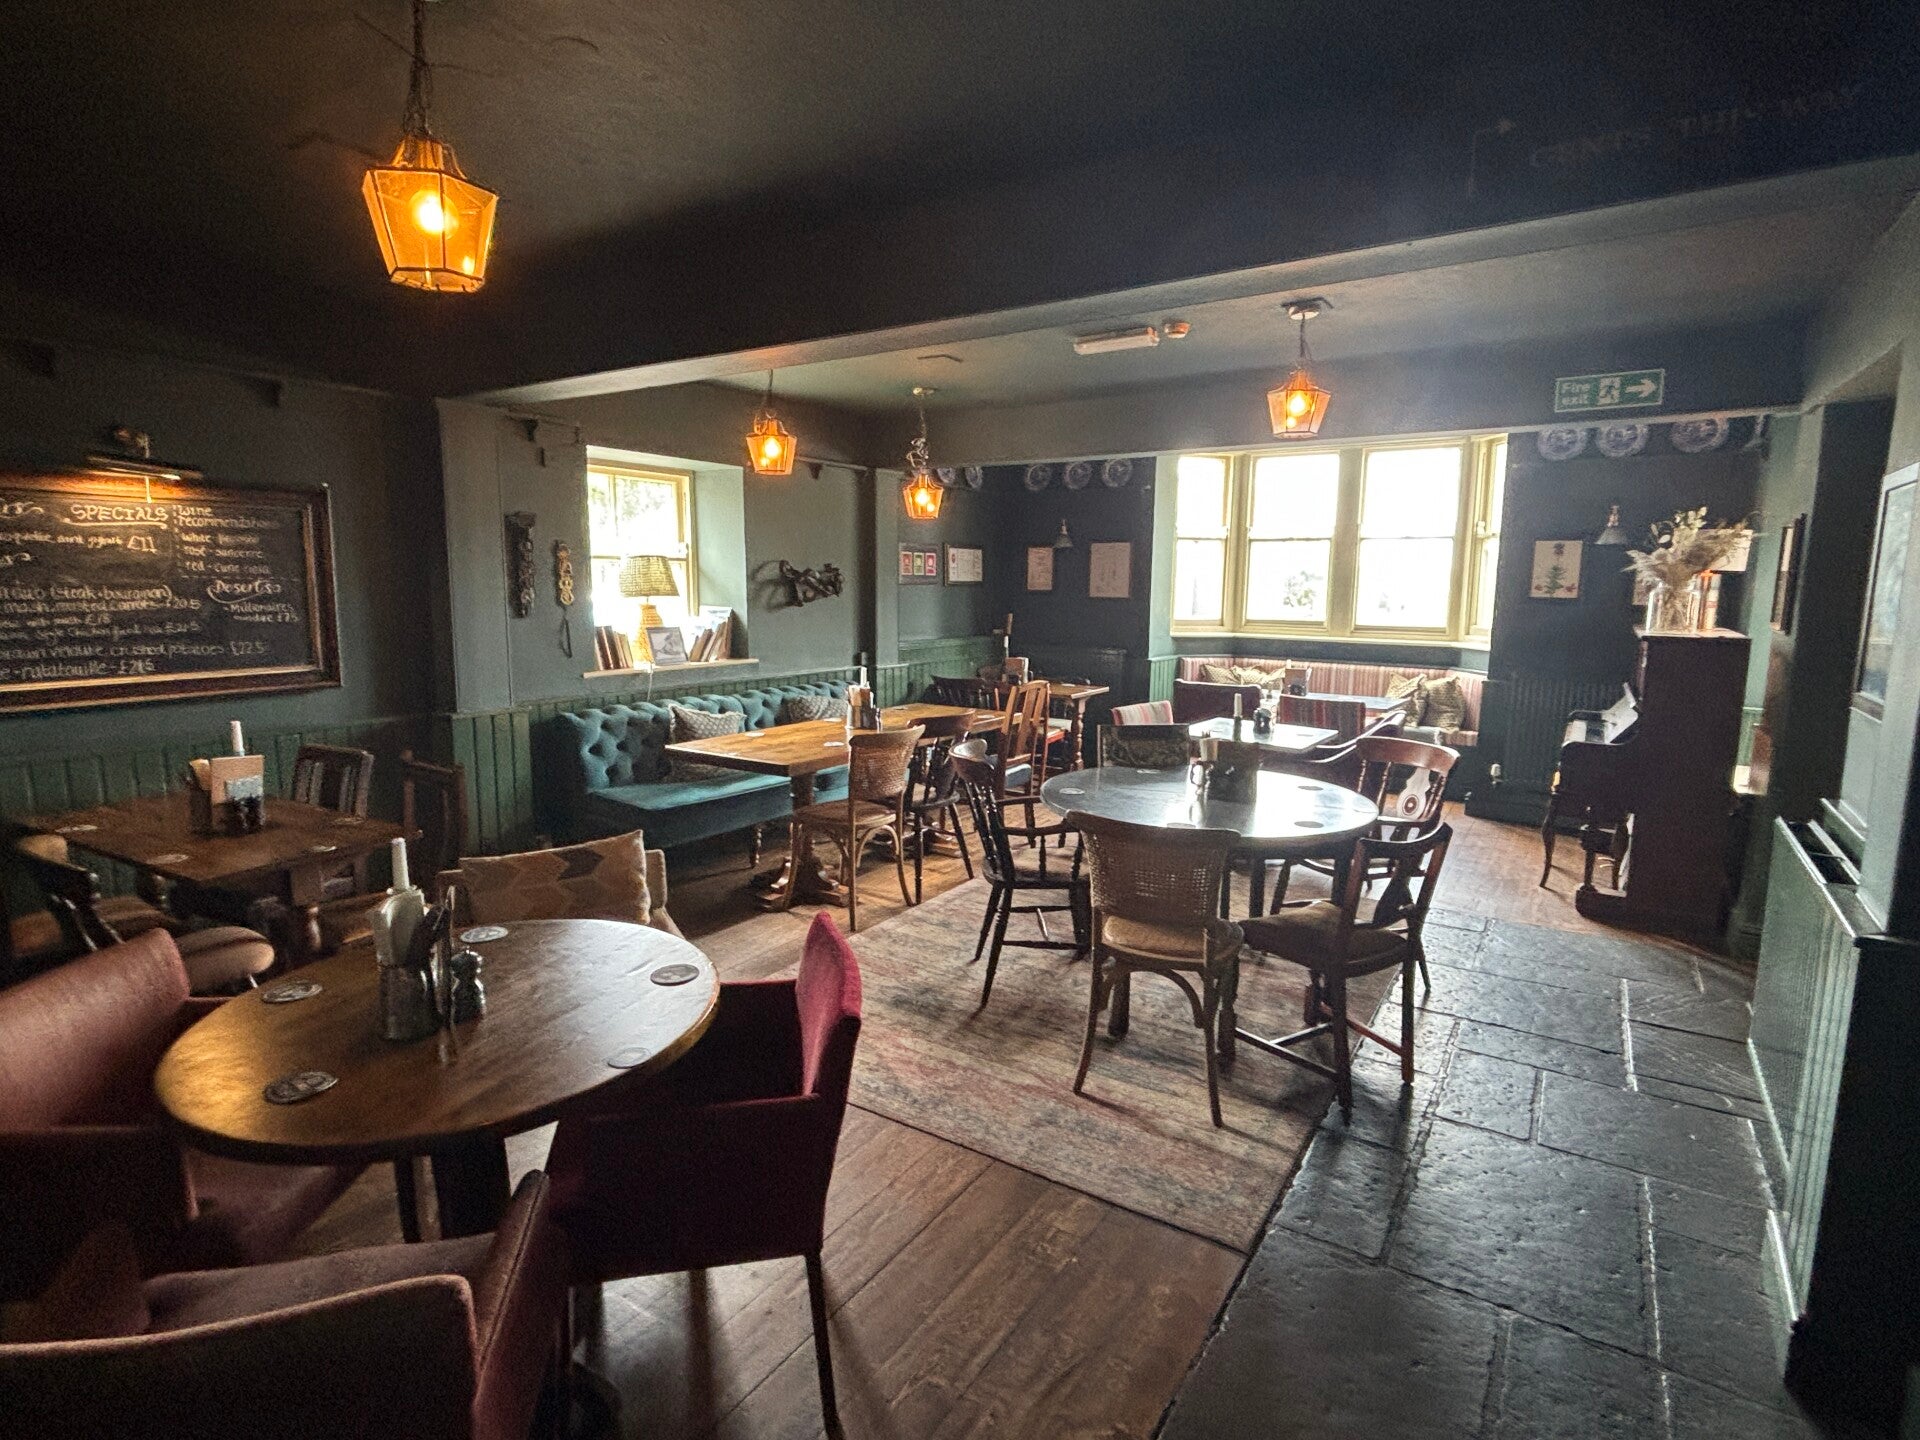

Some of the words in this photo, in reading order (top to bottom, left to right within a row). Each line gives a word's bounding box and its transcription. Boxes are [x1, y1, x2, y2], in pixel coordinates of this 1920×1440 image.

[1561, 382, 1591, 394] Fire
[1561, 394, 1588, 405] exit
[71, 503, 168, 521] SPECIALS
[127, 535, 157, 554] £11
